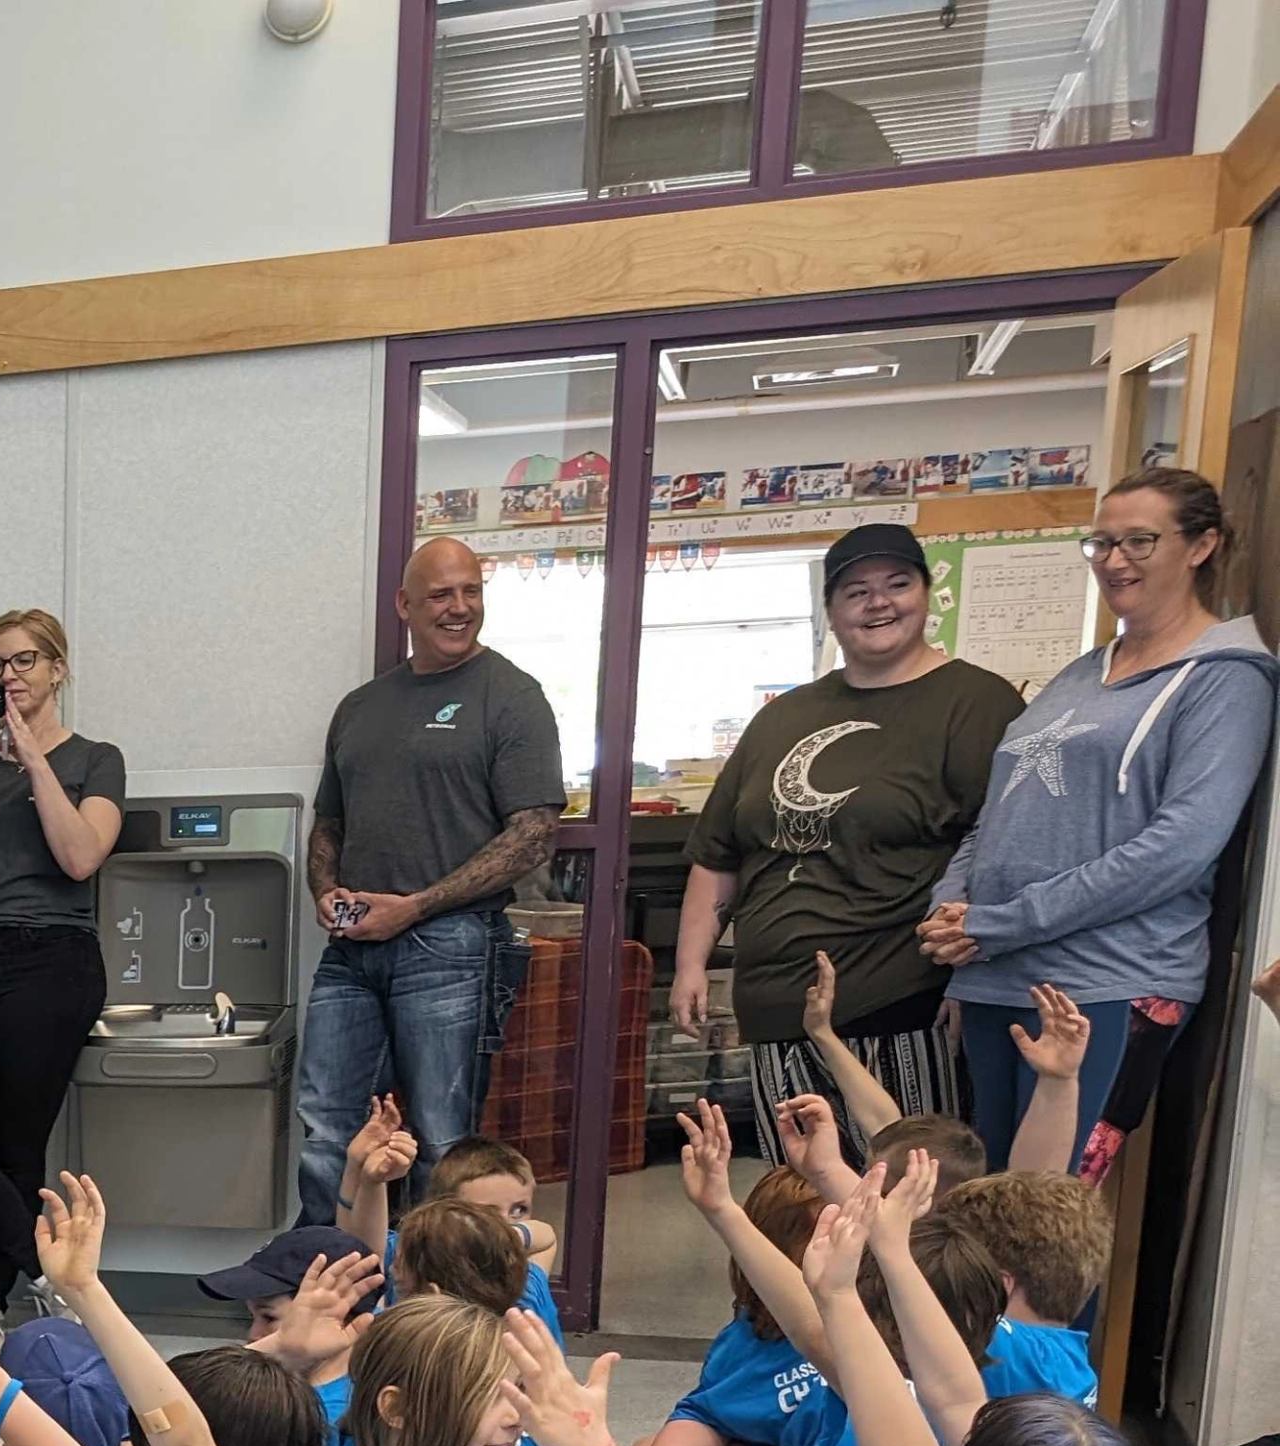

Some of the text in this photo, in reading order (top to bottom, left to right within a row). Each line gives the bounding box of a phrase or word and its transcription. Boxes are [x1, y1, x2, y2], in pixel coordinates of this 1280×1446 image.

[177, 812, 213, 821] ELKAY
[232, 937, 264, 945] ELKAY
[773, 1361, 821, 1389] CLASS
